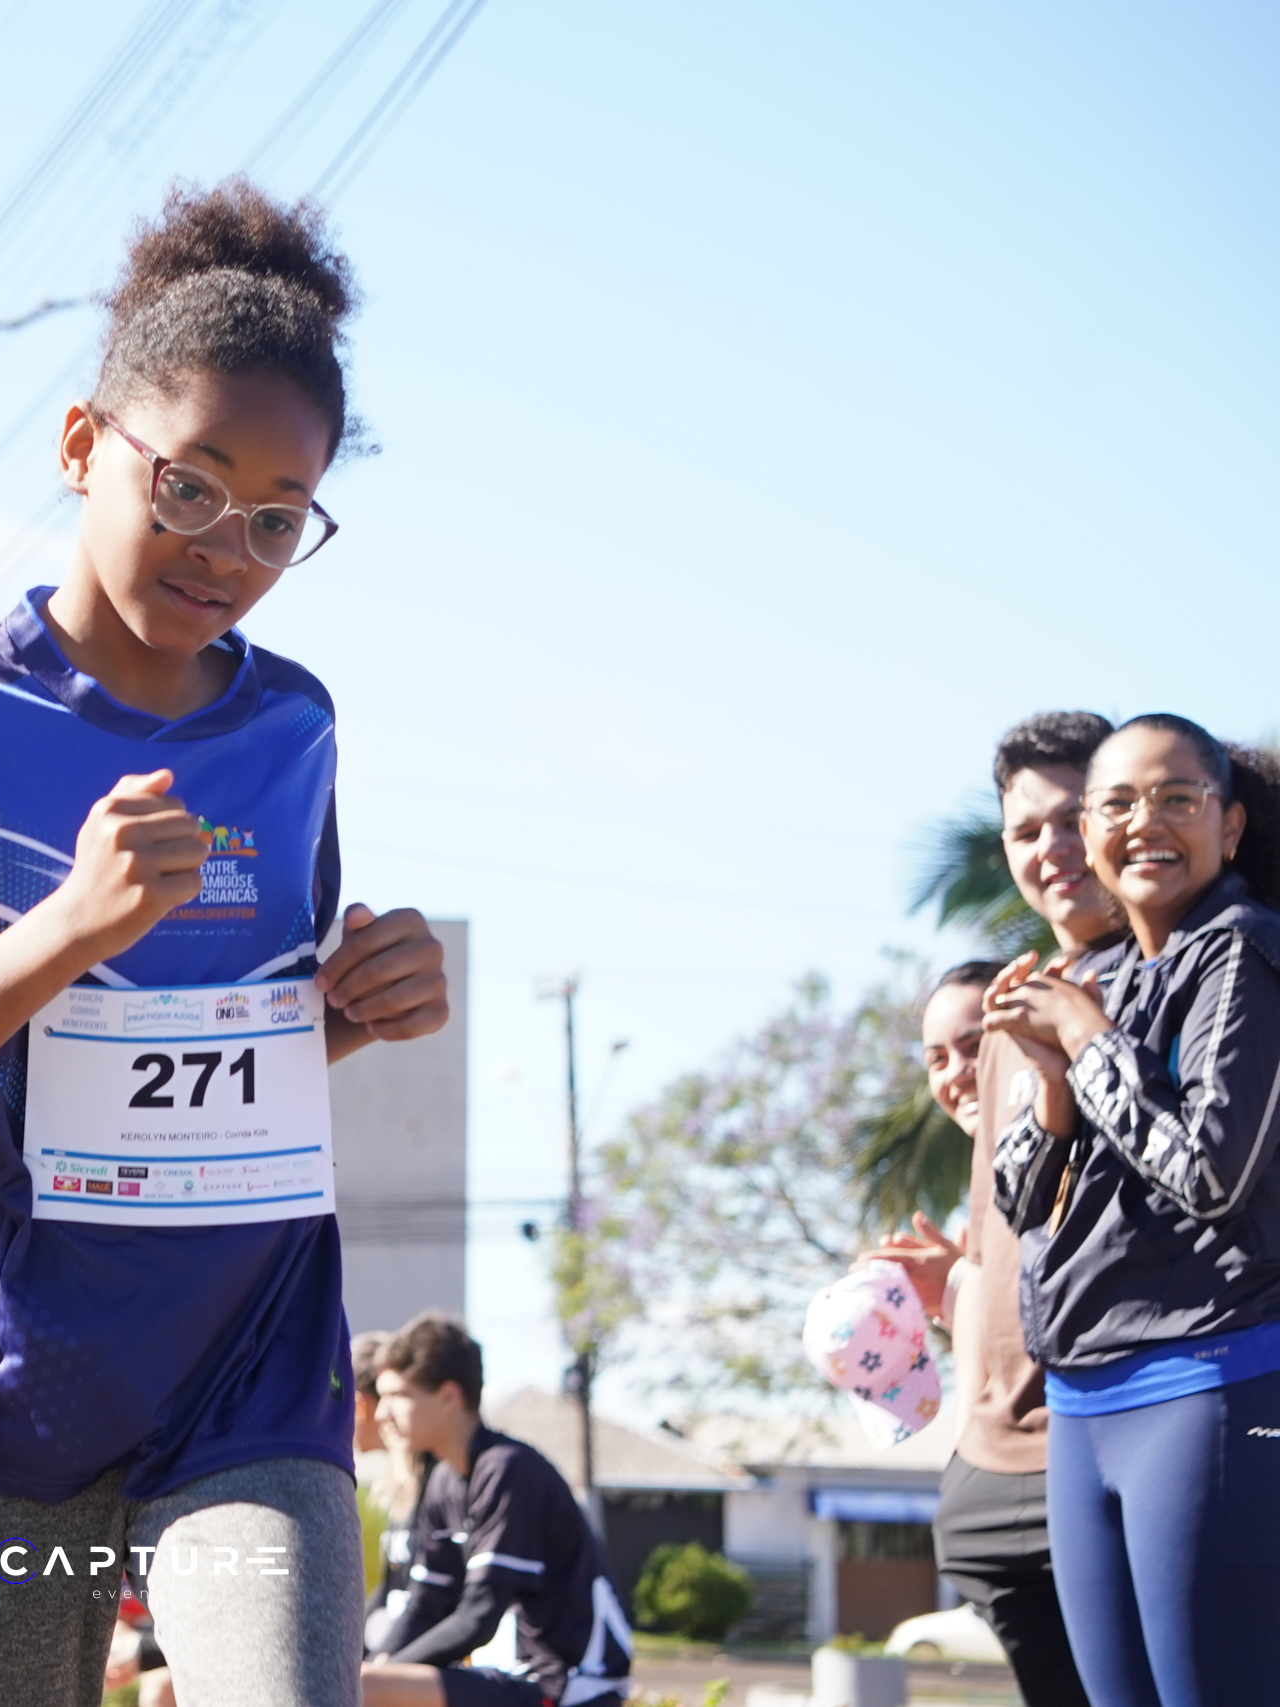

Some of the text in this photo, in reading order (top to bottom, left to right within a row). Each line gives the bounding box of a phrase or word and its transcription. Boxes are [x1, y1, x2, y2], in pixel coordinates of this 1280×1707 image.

[200, 860, 238, 876] ENTRE
[127, 1011, 200, 1023] PRATIQUE AJUDA
[271, 1010, 300, 1024] CAUSA
[128, 1047, 255, 1108] 271
[120, 1131, 166, 1142] KEROLYN
[168, 1131, 218, 1142] MONTEIRO
[224, 1129, 252, 1140] Corrida
[253, 1127, 269, 1137] Kids
[70, 1163, 108, 1176] Sicredi
